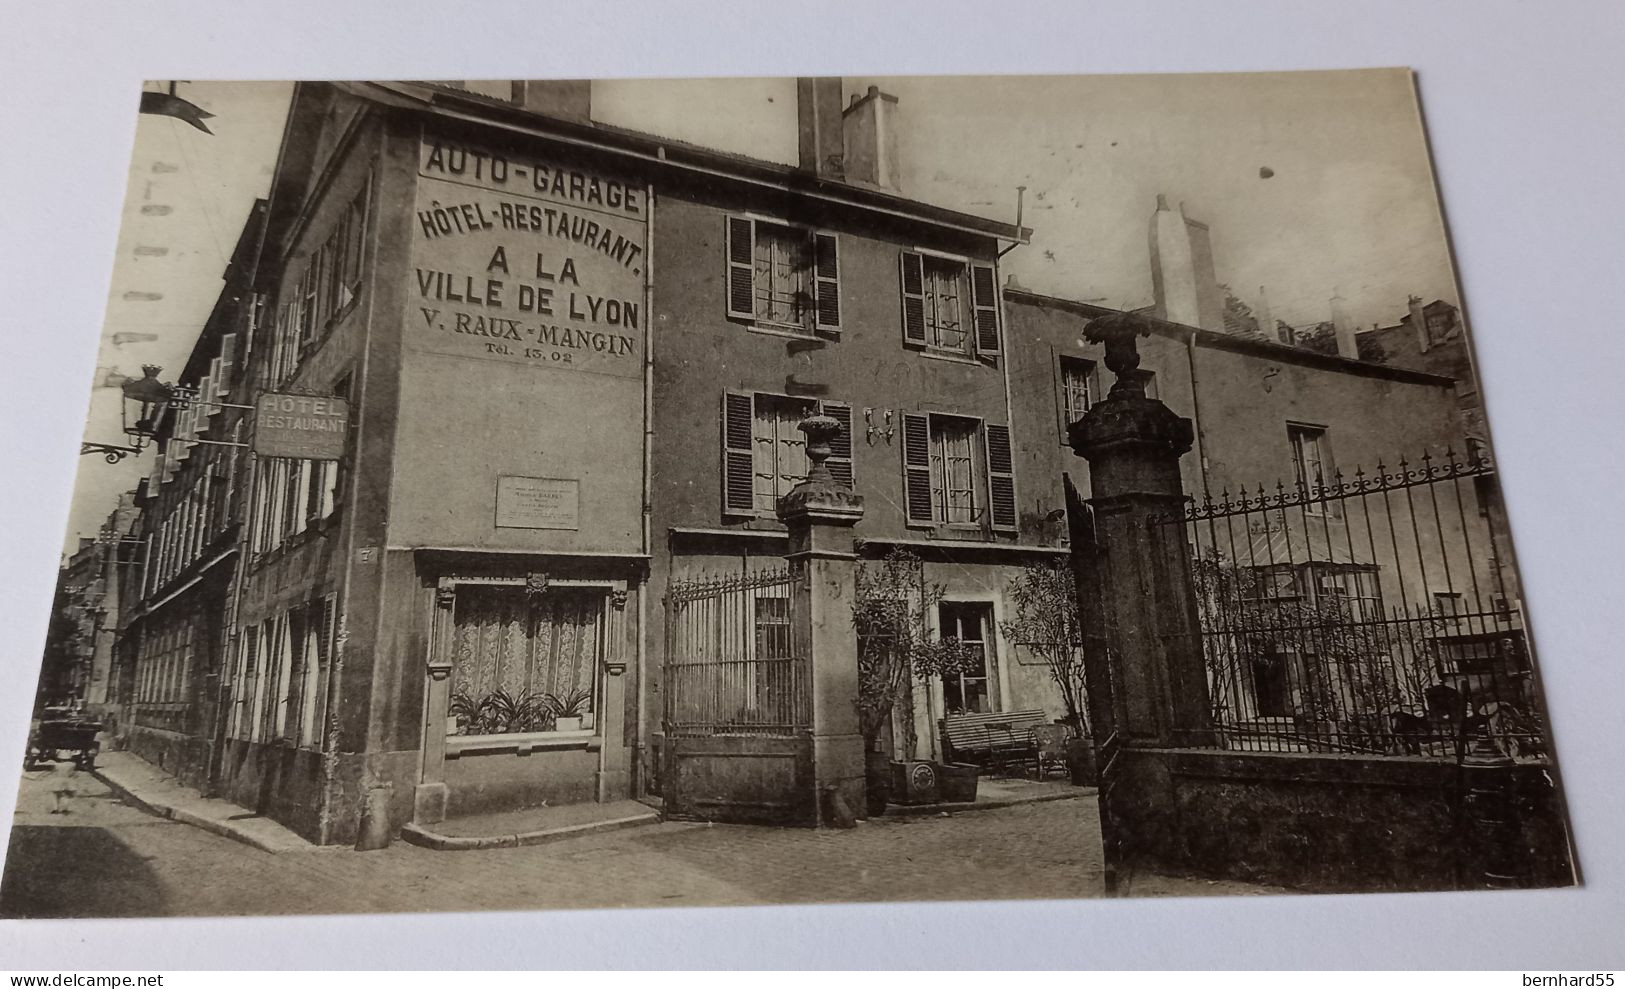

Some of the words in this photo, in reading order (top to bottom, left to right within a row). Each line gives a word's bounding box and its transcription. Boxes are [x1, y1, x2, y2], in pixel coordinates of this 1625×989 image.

[487, 245, 510, 275] A
[536, 252, 580, 286] LA
[416, 268, 503, 307] VILLE
[518, 284, 553, 316] DE
[569, 292, 639, 329] LYON
[420, 308, 444, 331] V.
[256, 414, 347, 433] RESTAURANT
